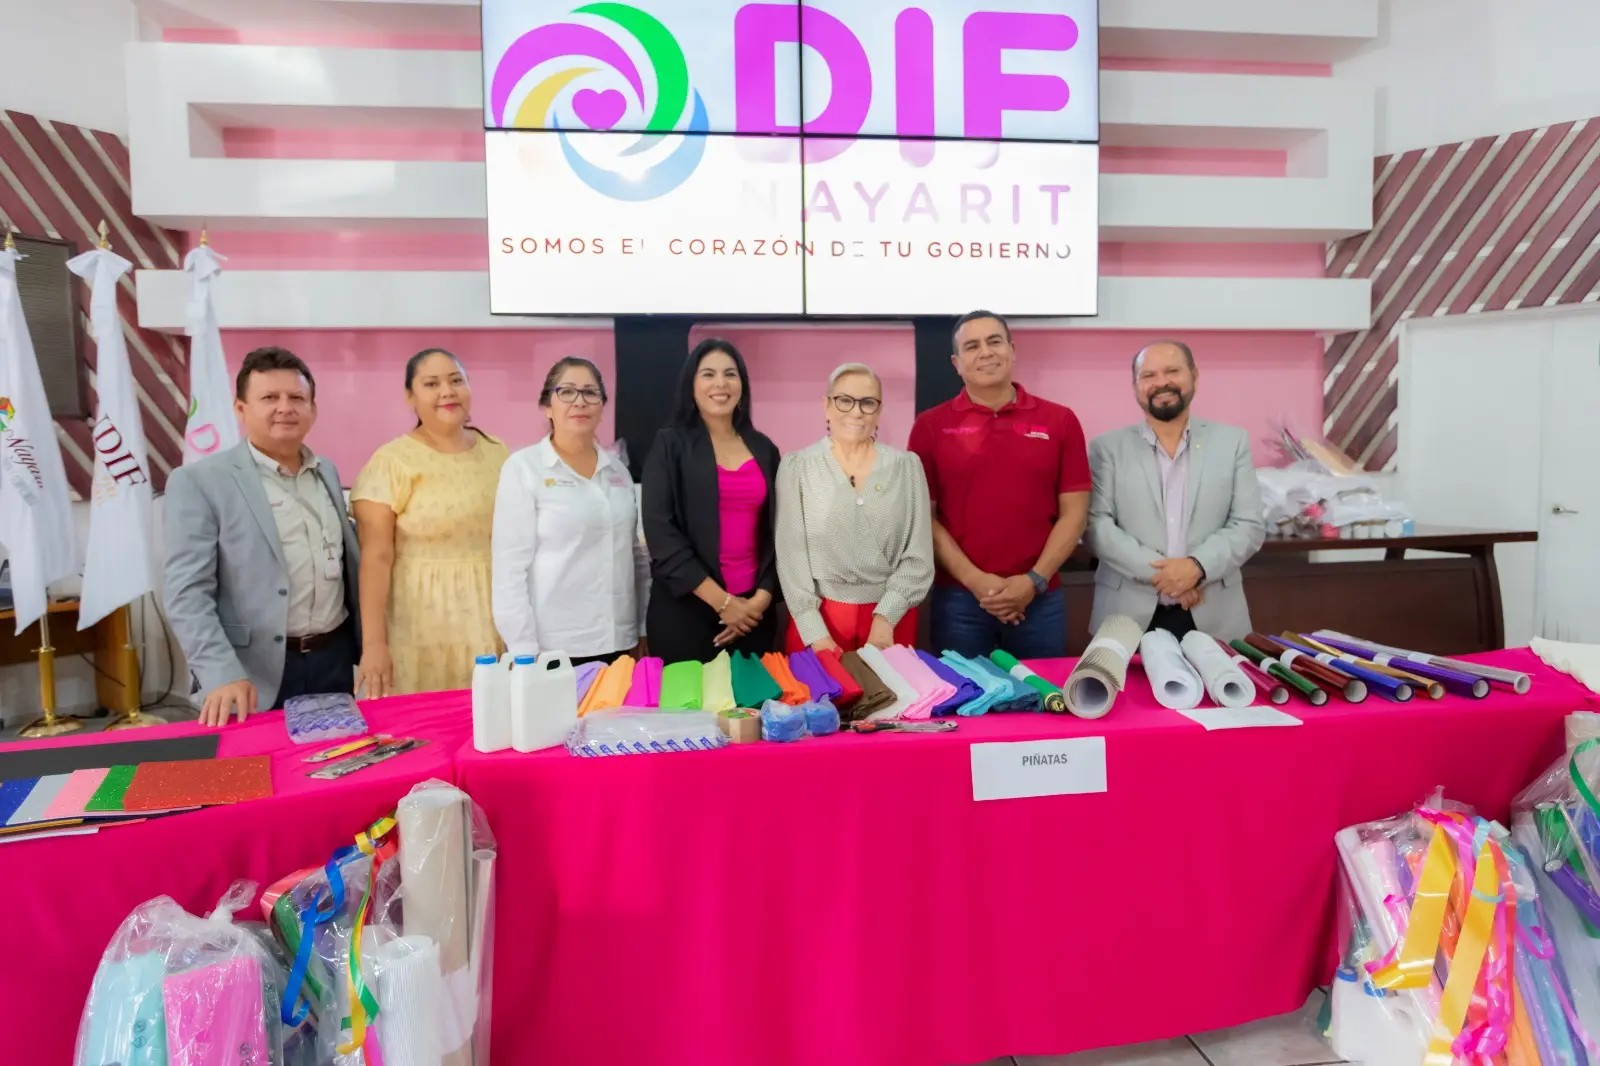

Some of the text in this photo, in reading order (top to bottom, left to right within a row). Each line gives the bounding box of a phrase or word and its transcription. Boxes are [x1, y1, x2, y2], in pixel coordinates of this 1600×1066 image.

[734, 3, 1078, 168] DIF
[501, 237, 605, 254] SOMOS
[669, 235, 814, 256] CORAZÓN
[880, 241, 912, 258] TU
[1022, 753, 1068, 766] PIÑATAS
